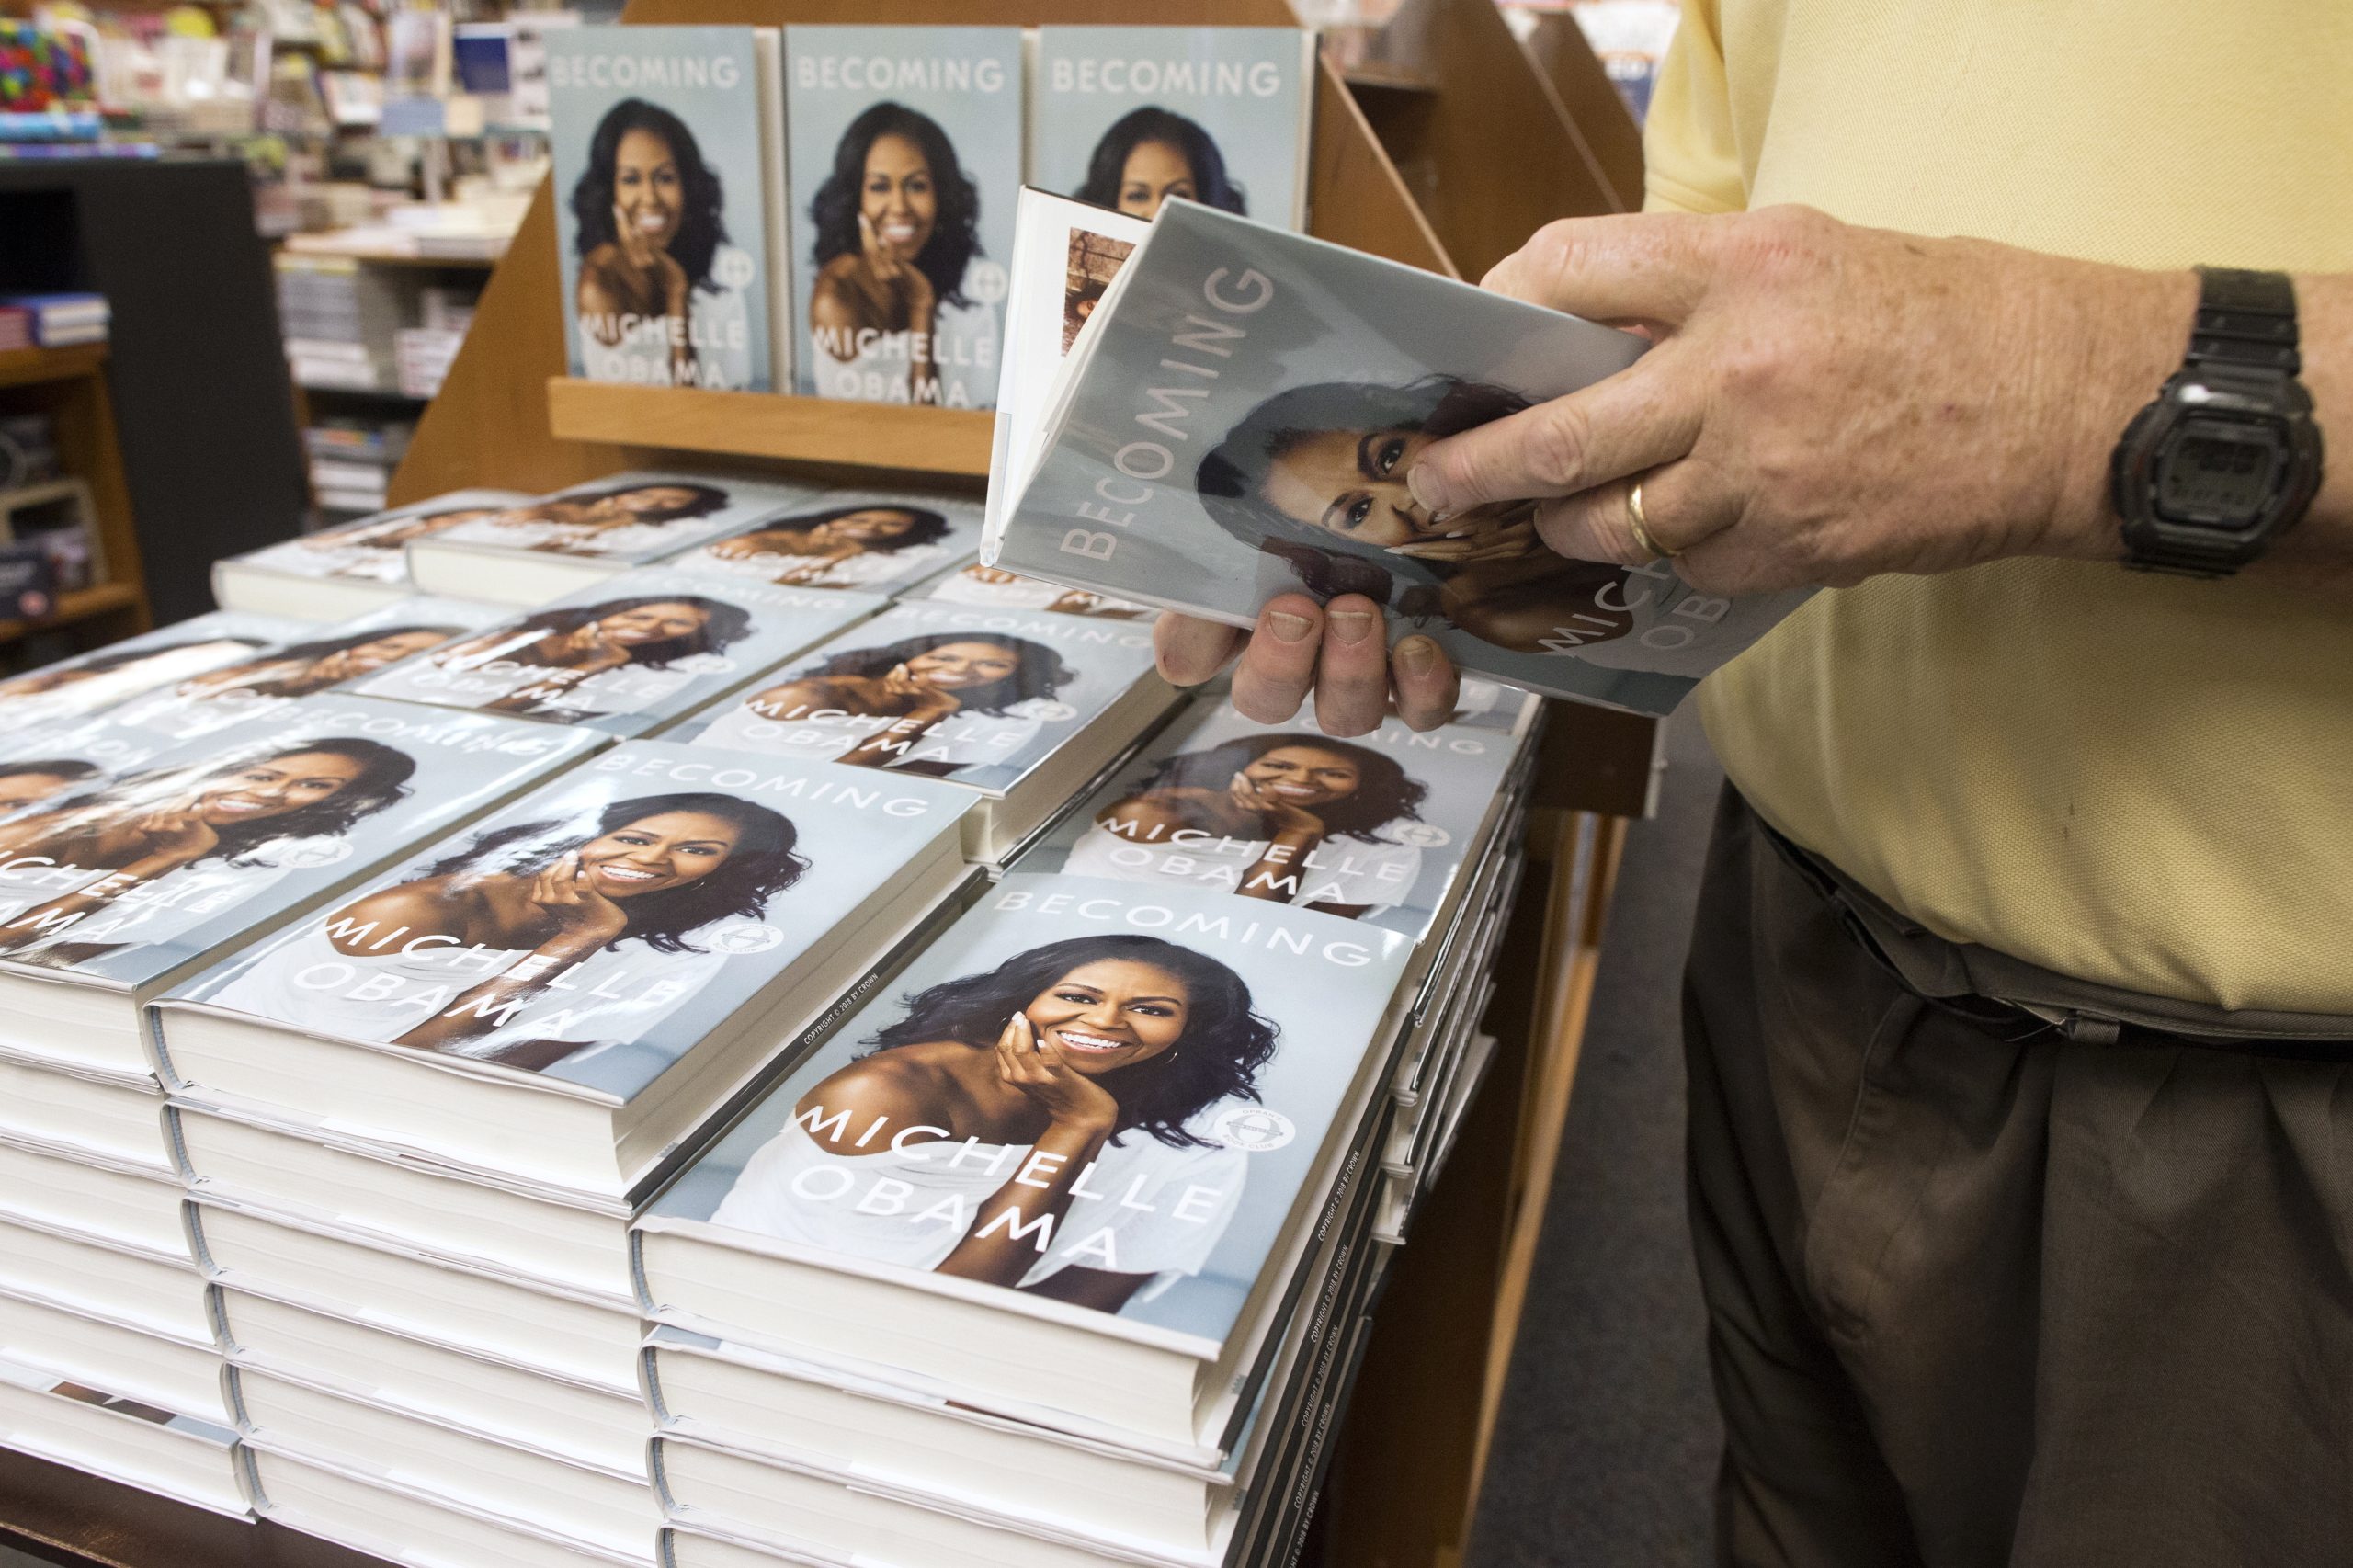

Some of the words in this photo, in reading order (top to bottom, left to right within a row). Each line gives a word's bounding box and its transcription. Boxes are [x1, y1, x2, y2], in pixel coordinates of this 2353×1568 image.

[551, 54, 741, 89] BECOMING
[796, 55, 1005, 93] BECOMING
[1051, 58, 1282, 97] BECOMING
[580, 312, 746, 349] MICHELLE
[813, 324, 994, 368] MICHELLE
[835, 369, 970, 407] OBAMA
[1059, 267, 1274, 562] BECOMING
[1537, 559, 1669, 658] MICH
[742, 722, 949, 762] OBAMA
[743, 699, 1023, 748] MICHELLE
[595, 753, 929, 818] BECOMING
[1097, 816, 1404, 883] MICHELLE
[1108, 846, 1347, 903] OBAMA
[993, 891, 1371, 968] BECOMING
[306, 916, 687, 1008] MICHELLE
[292, 961, 575, 1040] OBAMA
[803, 1013, 835, 1045] COPYRIGHT
[839, 997, 853, 1011] 2018
[850, 992, 860, 1000] BY
[858, 973, 879, 994] CROWN
[779, 1105, 1222, 1224] MICHELLE
[791, 1164, 1118, 1267] OBAMA
[1317, 1204, 1338, 1242] COPYRIGHT
[1336, 1182, 1347, 1198] 2018
[1342, 1174, 1350, 1184] BY
[1347, 1150, 1360, 1175] CROWN
[1311, 1301, 1329, 1343] COPYRIGHT
[1332, 1269, 1340, 1279] BY
[1336, 1244, 1348, 1270] CROWN
[1326, 1324, 1339, 1352] CROWN
[1318, 1402, 1331, 1430] CROWN
[1306, 1490, 1320, 1518] CROWN
